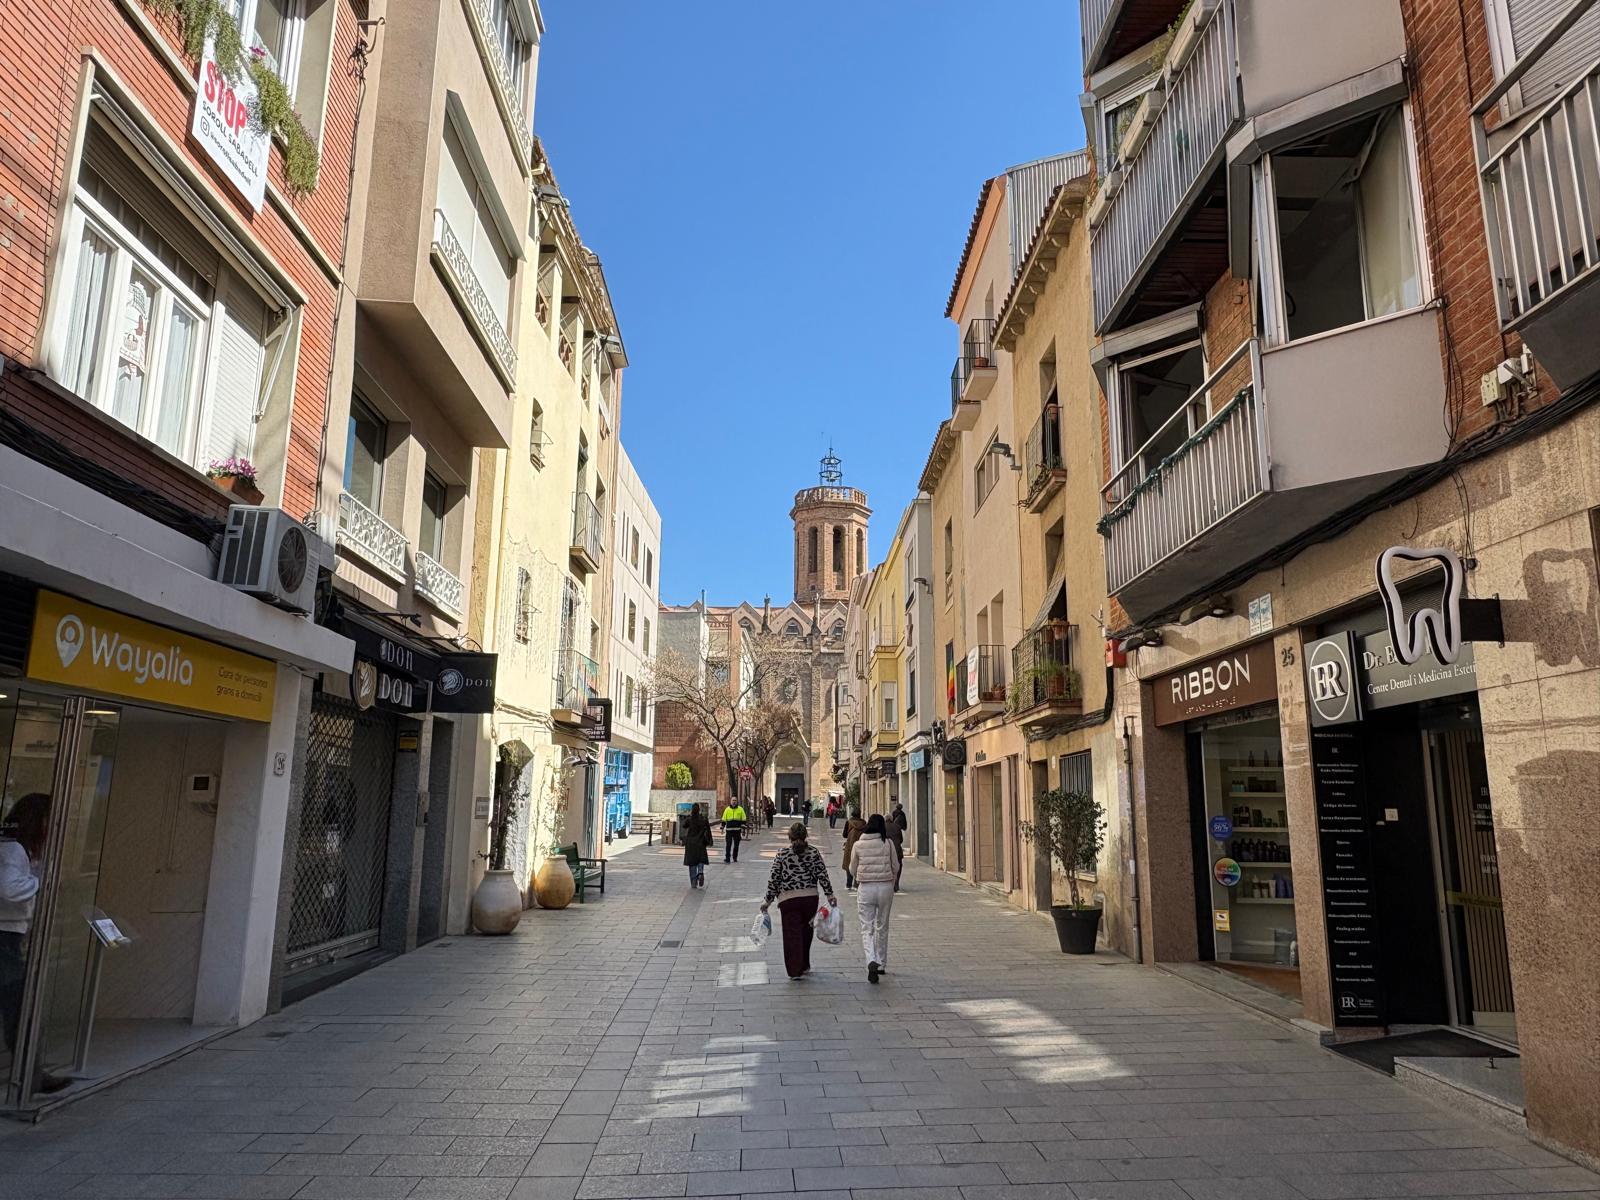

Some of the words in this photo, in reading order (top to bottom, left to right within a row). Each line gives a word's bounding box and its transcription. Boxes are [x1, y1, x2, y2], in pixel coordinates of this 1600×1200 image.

[205, 60, 247, 138] STOP
[203, 101, 227, 137] SOROLL
[228, 133, 259, 177] SABADELL
[91, 625, 193, 687] Wayalia
[1171, 653, 1251, 704] RIBBON
[1281, 646, 1295, 668] 25
[1363, 651, 1385, 670] Dr.
[1367, 683, 1389, 695] Centre
[1390, 673, 1413, 690] Dental
[1413, 675, 1417, 685] i
[1418, 667, 1453, 685] Medicina
[1454, 661, 1477, 677] Estèti
[1310, 660, 1347, 702] ER
